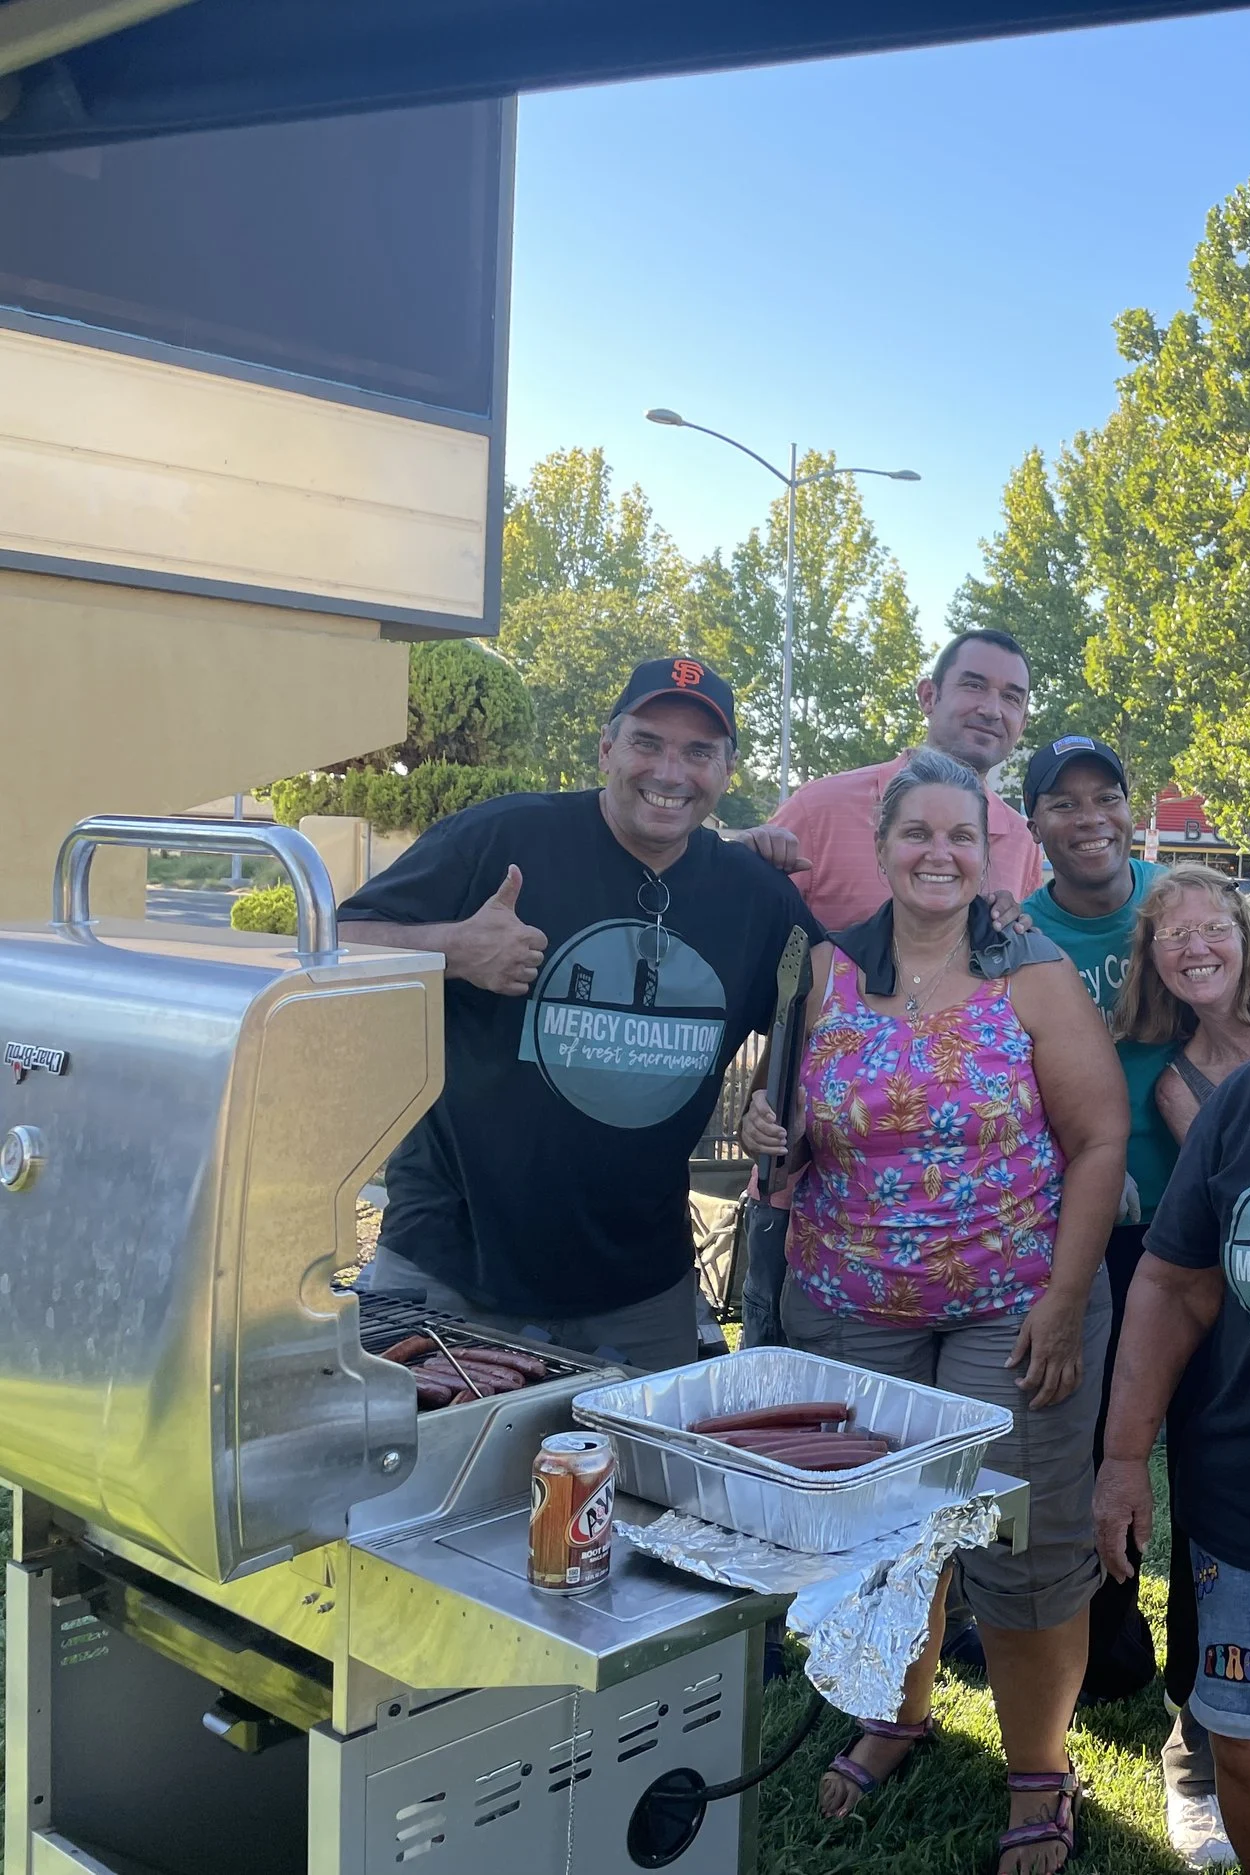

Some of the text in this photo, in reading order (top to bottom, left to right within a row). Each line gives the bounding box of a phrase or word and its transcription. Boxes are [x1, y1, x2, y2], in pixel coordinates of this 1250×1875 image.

[671, 659, 705, 688] SF
[544, 1006, 719, 1052] MERCY COALITION
[559, 1038, 708, 1070] of west sacramento
[581, 1546, 602, 1560] ROOT
